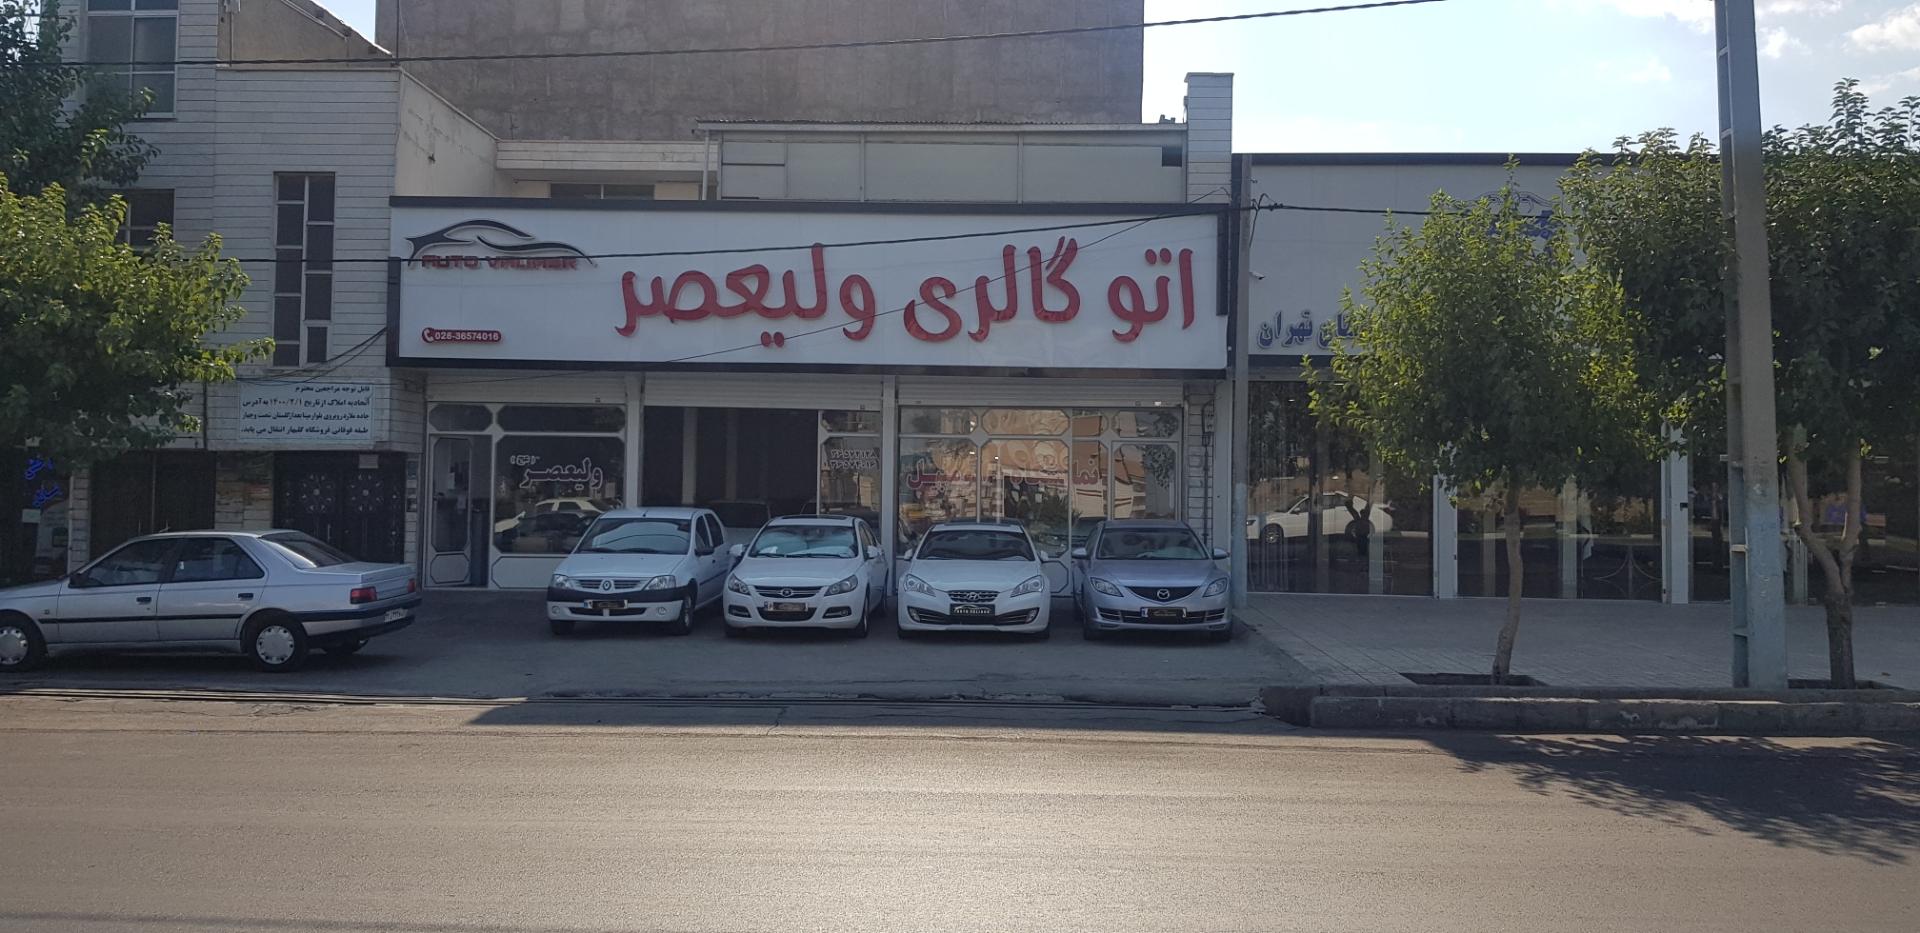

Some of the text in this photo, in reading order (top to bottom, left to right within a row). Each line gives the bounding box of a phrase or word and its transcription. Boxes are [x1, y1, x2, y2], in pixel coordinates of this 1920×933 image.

[421, 254, 480, 269] AUTO
[613, 235, 1195, 348] اتو گالری ولیعصر
[1257, 308, 1314, 348] تهران
[519, 457, 604, 491] ولیعصر
